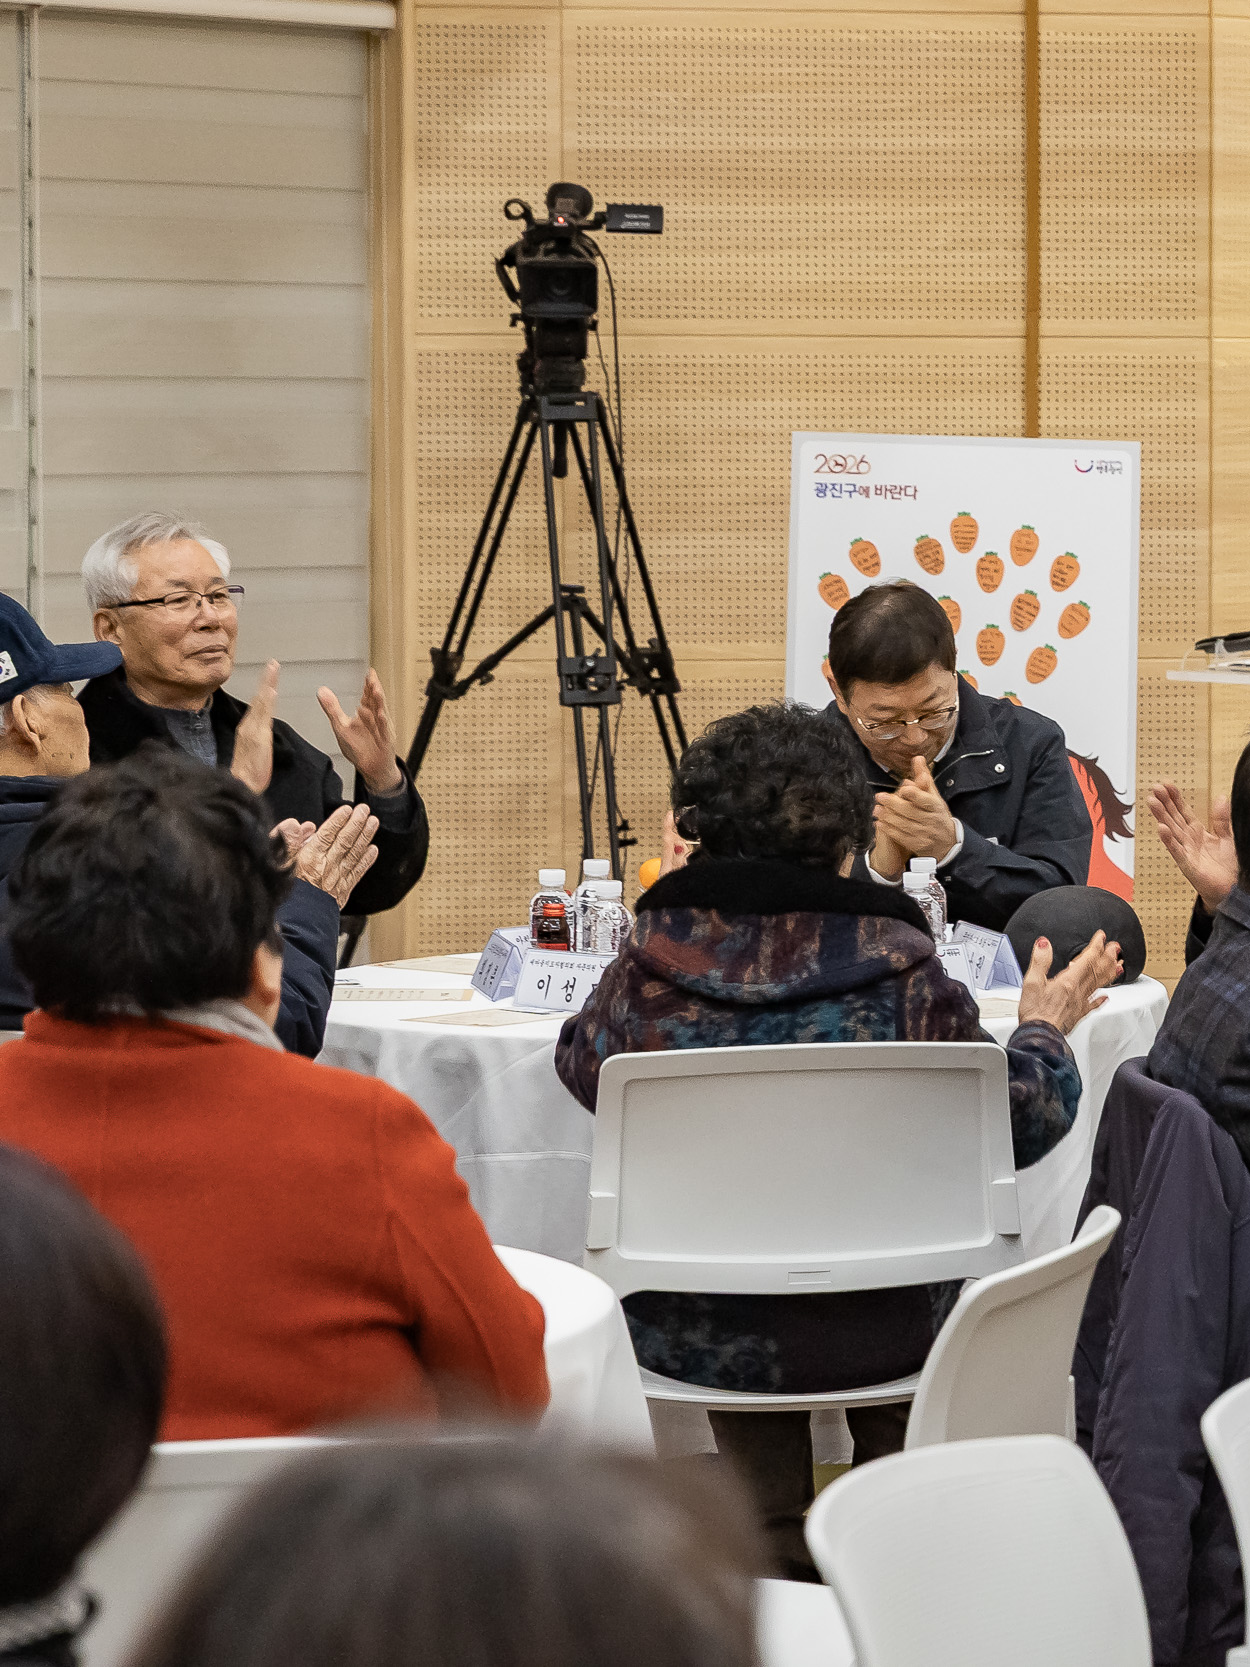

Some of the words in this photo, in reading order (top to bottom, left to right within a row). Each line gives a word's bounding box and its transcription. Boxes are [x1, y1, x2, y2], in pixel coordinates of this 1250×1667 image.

[814, 453, 871, 475] 2026
[814, 482, 871, 499] 광진구에
[874, 484, 918, 501] 바란다
[537, 974, 599, 1003] 이성
